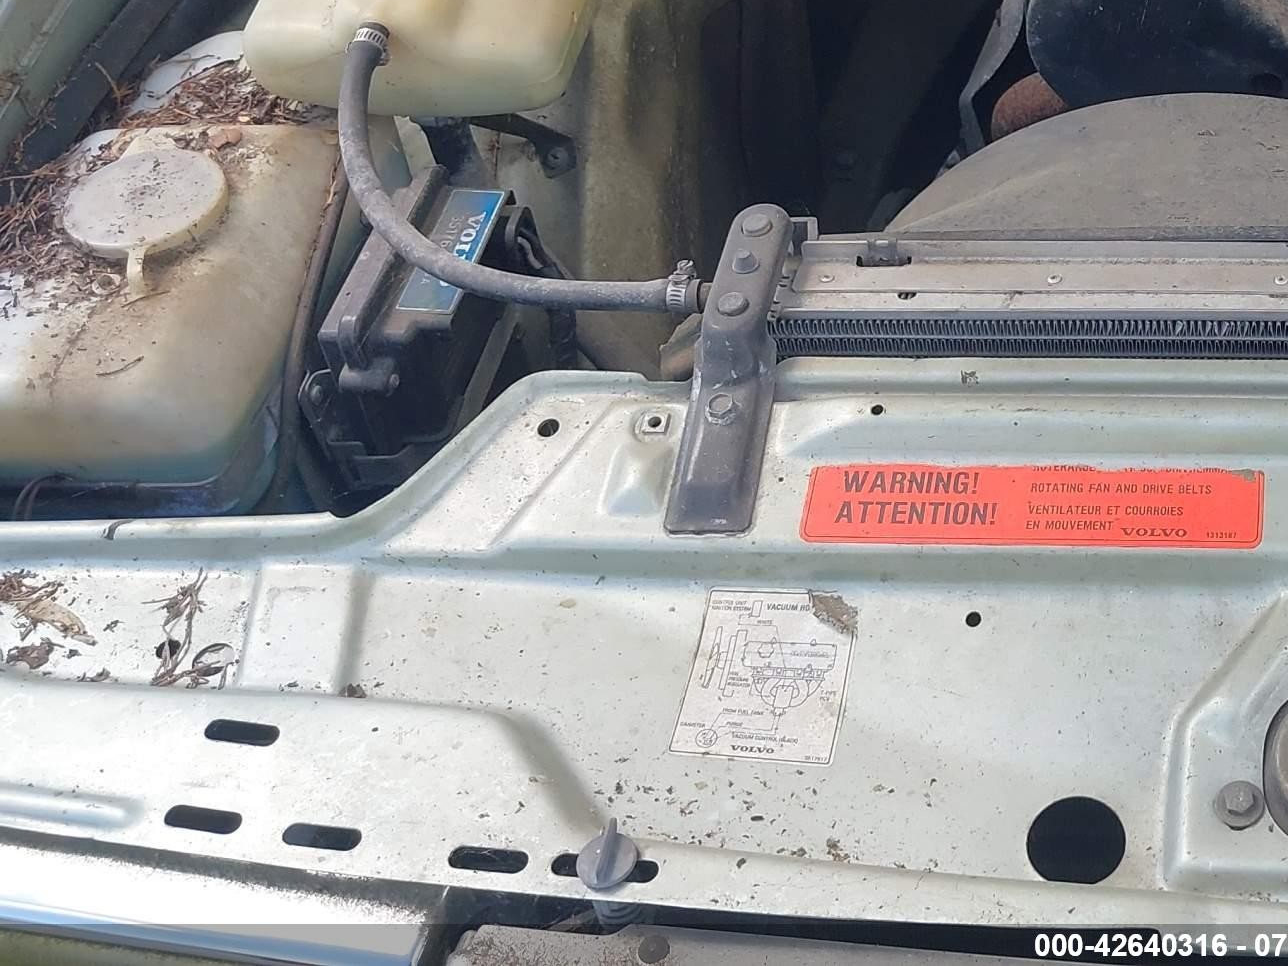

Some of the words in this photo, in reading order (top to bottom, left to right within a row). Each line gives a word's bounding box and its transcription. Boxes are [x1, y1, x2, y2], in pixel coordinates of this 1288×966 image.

[844, 470, 980, 494] WARNING!
[1030, 483, 1083, 493] ROTATING
[1088, 483, 1111, 493] FAN
[1116, 484, 1138, 493] AND
[1143, 484, 1174, 494] DRIVE
[1179, 485, 1212, 495] BELTS
[834, 501, 998, 525] ATTENTION!
[1028, 505, 1101, 515] VENTILATEUR
[1107, 506, 1120, 515] ET
[1125, 506, 1184, 516] COURROIES
[1026, 520, 1040, 530] EN
[1045, 520, 1114, 531] MOUVEMENT
[1120, 527, 1188, 538] VOLVO
[766, 603, 798, 612] VACUUM
[731, 744, 775, 755] VOLVO
